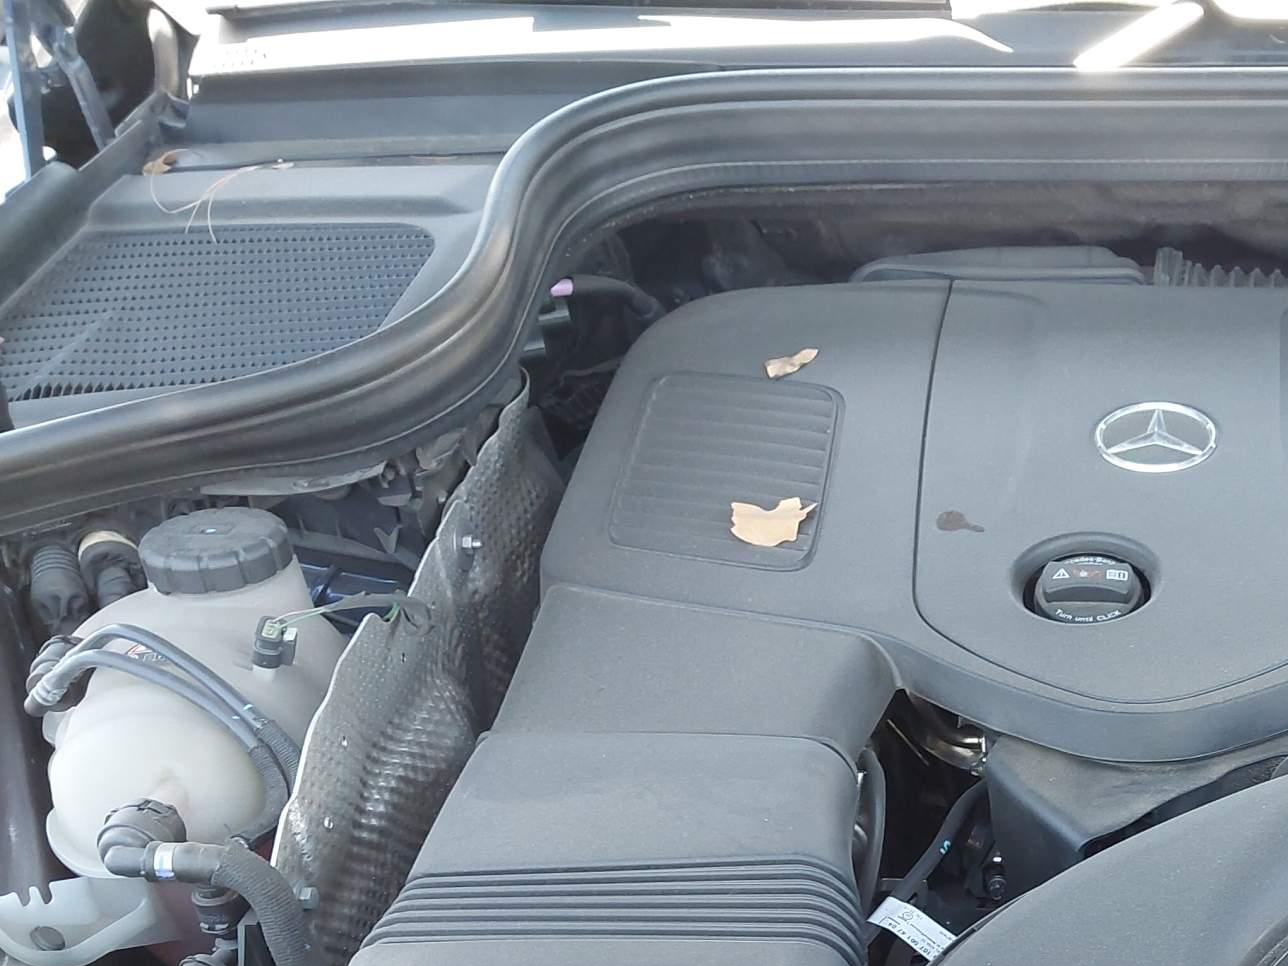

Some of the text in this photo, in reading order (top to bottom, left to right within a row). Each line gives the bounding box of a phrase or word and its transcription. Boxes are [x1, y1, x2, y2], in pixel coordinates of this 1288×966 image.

[1056, 609, 1122, 623] Turn until CLICK
